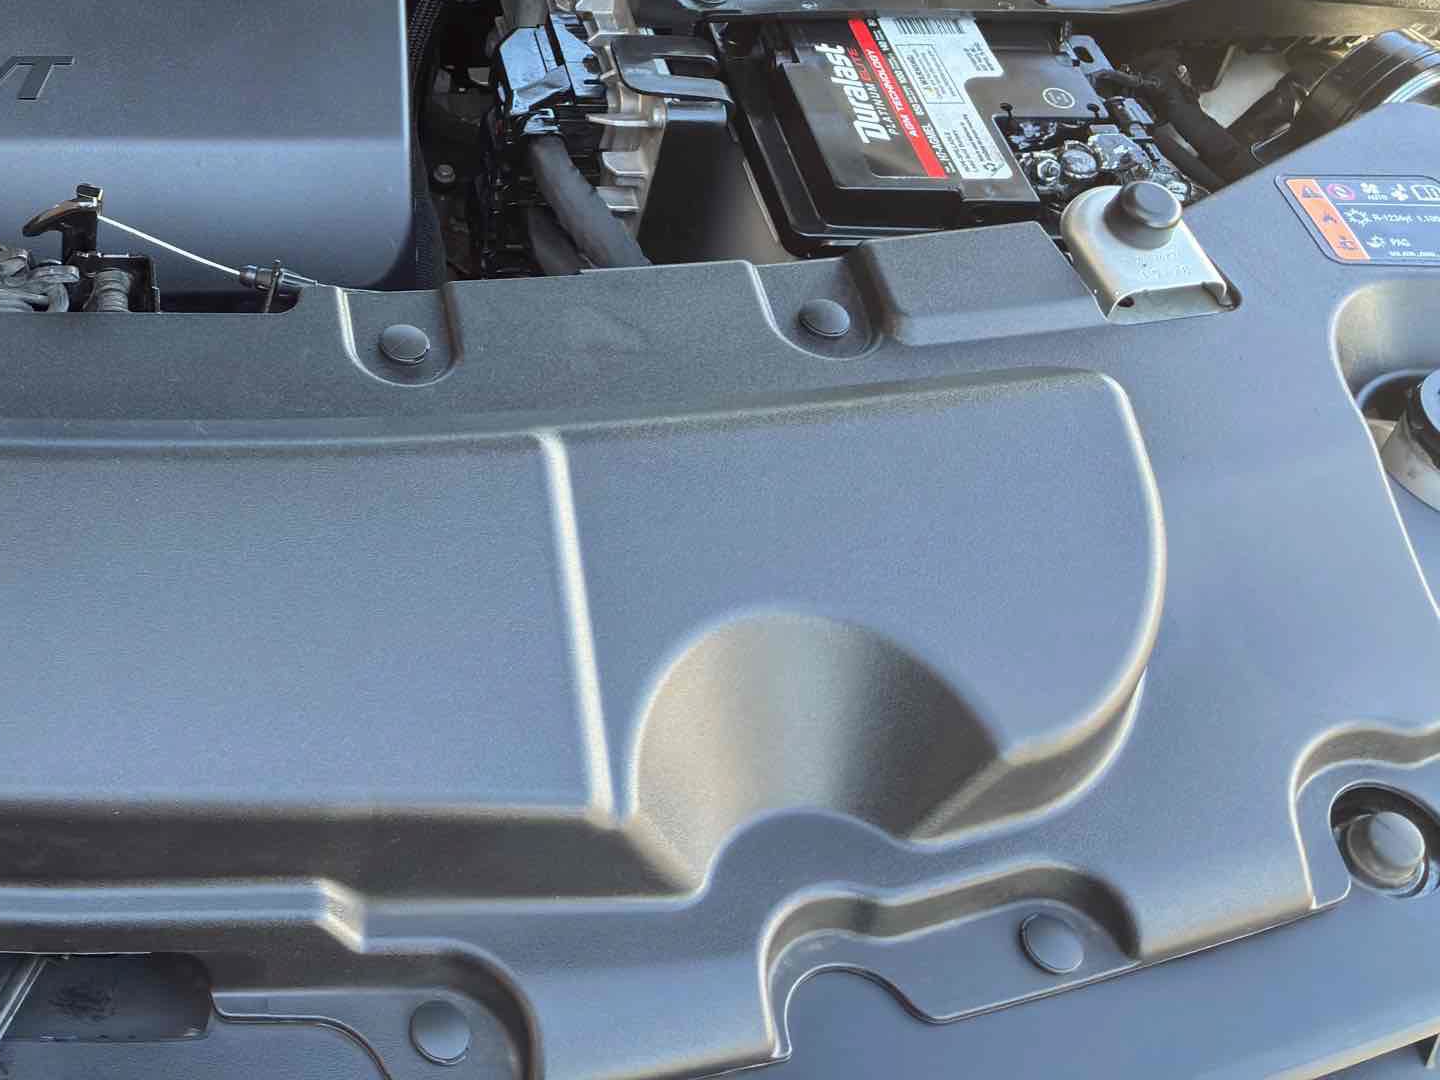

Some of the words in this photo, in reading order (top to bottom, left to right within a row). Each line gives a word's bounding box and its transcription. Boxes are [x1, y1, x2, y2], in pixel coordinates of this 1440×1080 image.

[814, 42, 891, 144] Duralast
[866, 48, 905, 111] TECHNOLOGY
[864, 83, 899, 135] PLATINUM
[900, 114, 919, 137] AGM
